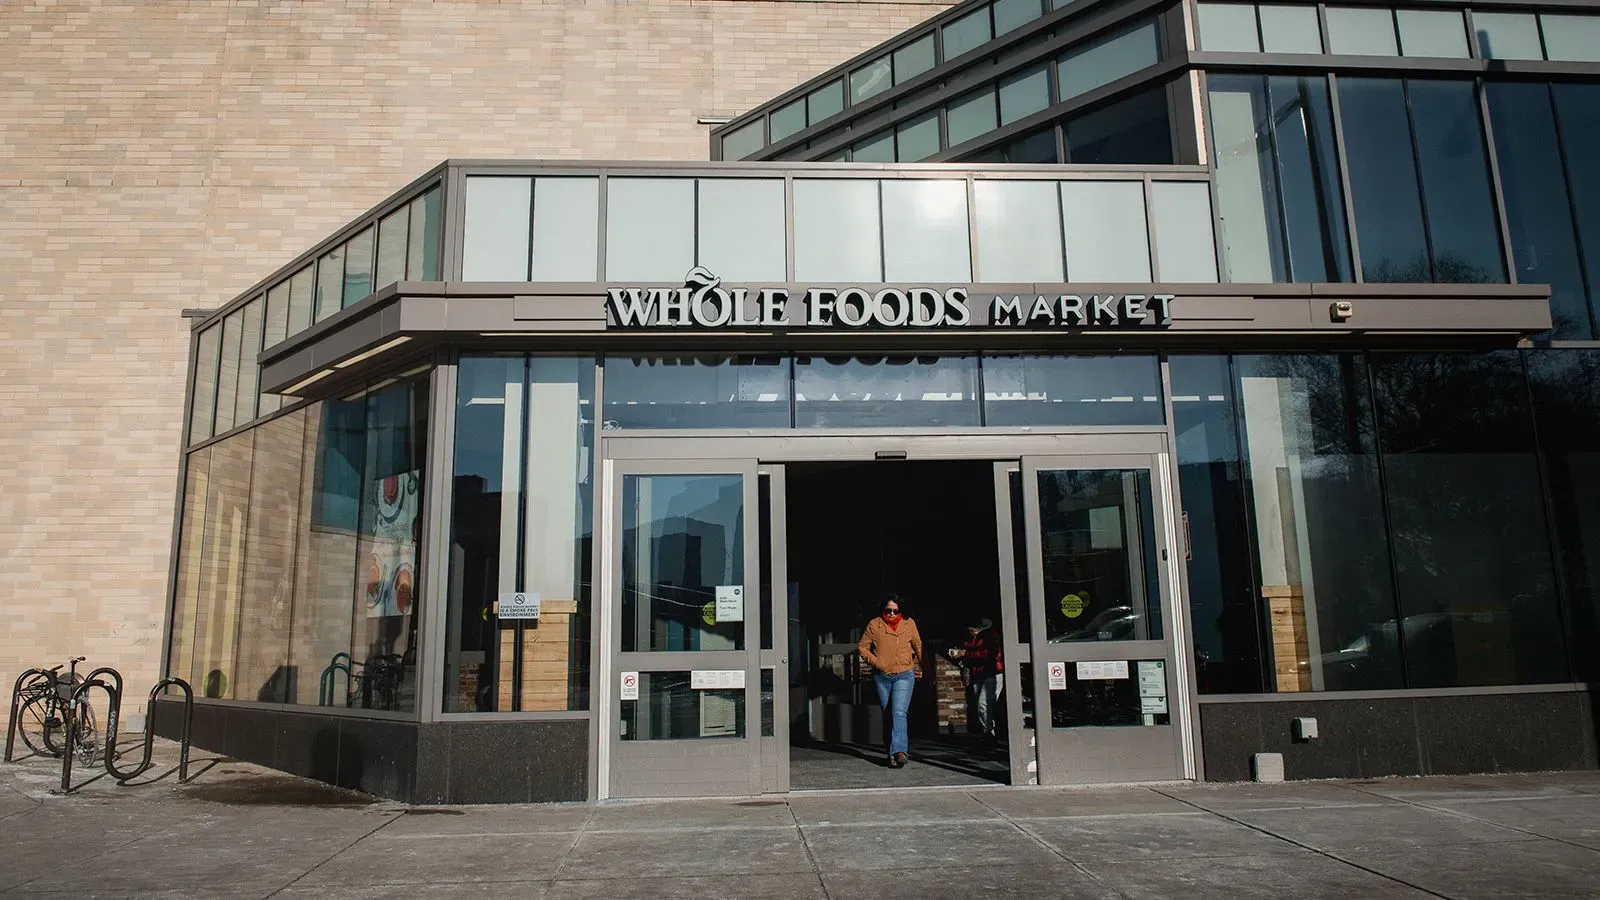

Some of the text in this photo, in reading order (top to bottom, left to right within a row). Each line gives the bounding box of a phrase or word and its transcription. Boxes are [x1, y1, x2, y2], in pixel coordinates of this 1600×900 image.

[606, 266, 1176, 327] WHOLE FOODS MARKET
